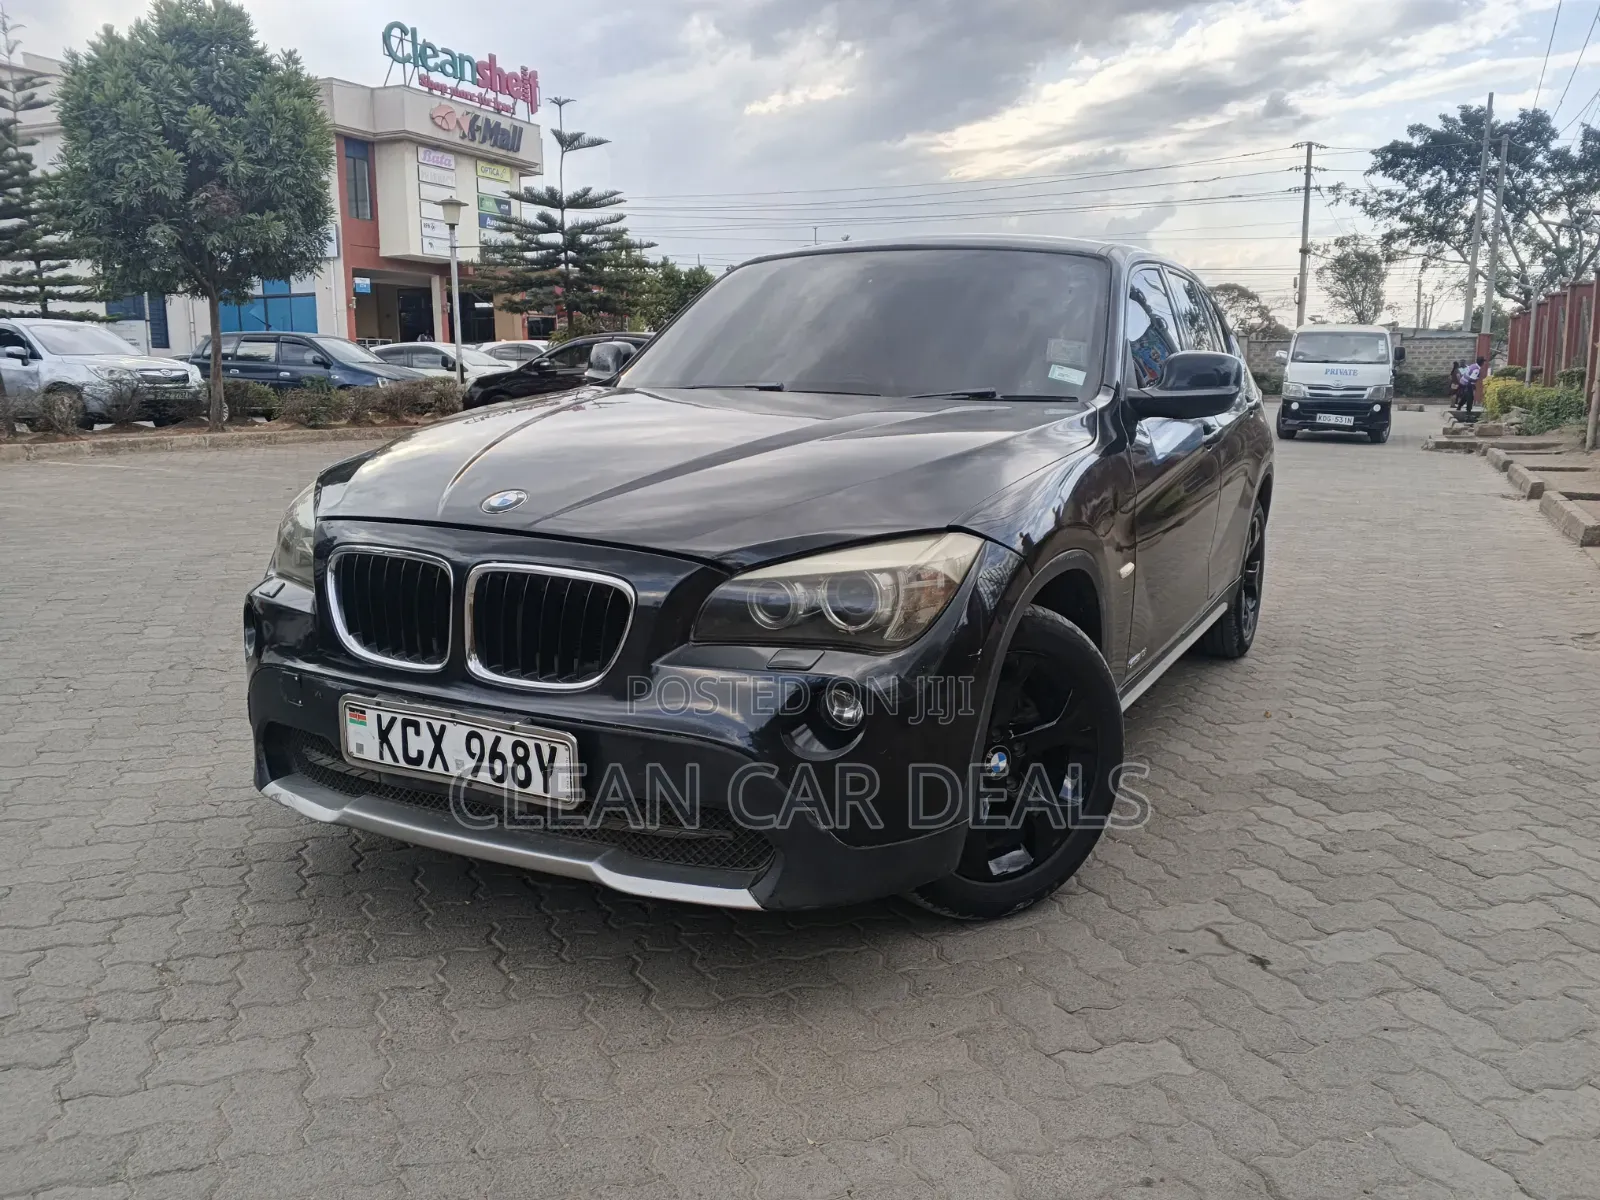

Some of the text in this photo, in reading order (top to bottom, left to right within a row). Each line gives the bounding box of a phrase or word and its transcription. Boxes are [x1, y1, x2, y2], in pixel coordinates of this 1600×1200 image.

[384, 20, 539, 114] Cleanshelf
[419, 73, 447, 96] Shop
[449, 86, 476, 101] more
[477, 91, 493, 107] for
[421, 149, 453, 167] Bata
[480, 165, 500, 177] OPTICA
[1324, 368, 1358, 377] PRIVATE
[1334, 415, 1353, 424] 531N
[376, 713, 450, 772] KCX
[464, 729, 558, 794] 968Y
